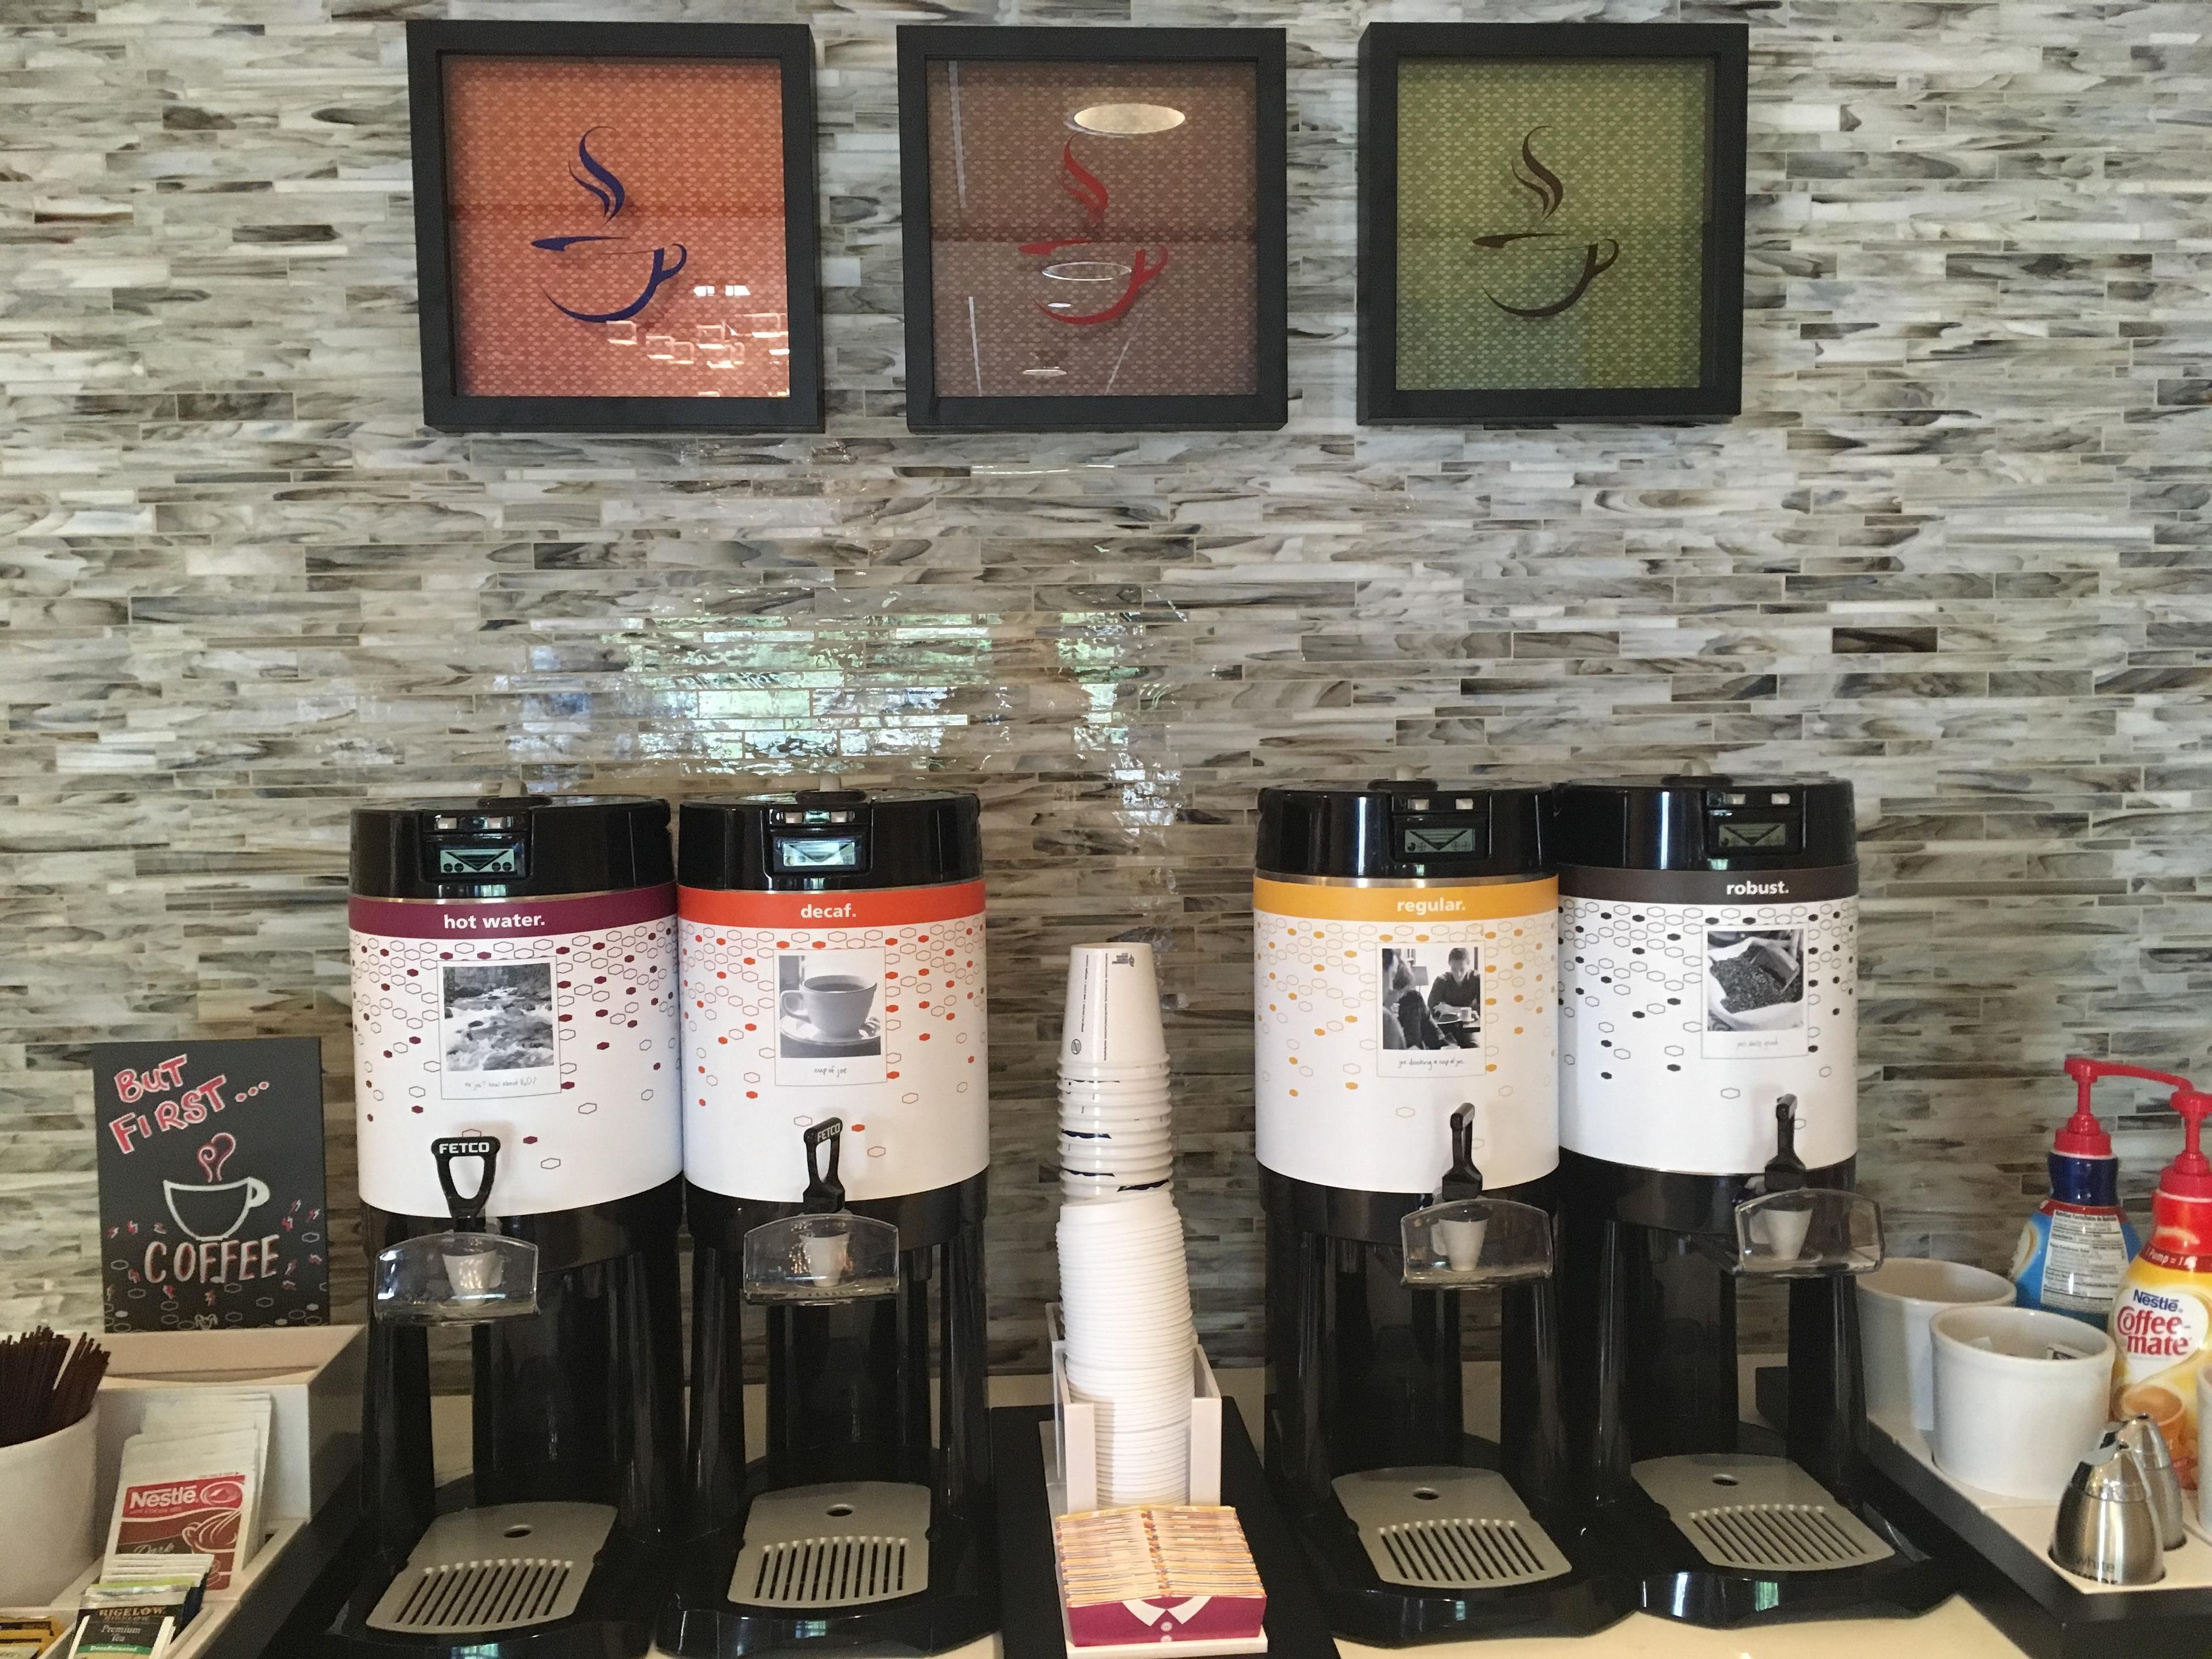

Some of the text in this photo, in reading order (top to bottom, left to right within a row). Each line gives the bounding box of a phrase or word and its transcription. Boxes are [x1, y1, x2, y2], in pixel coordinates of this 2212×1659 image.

[1726, 880, 1789, 895] robust.
[800, 903, 857, 918] decaf.
[1397, 897, 1466, 916] regular.
[444, 913, 546, 929] hot water.
[828, 1065, 835, 1073] of
[836, 1067, 847, 1078] joe
[817, 1122, 841, 1143] FETCO
[439, 1142, 490, 1154] FETCO
[144, 1234, 281, 1283] COFFEE
[2148, 1248, 2170, 1266] Pump
[2127, 1335, 2189, 1356] mate
[101, 1624, 142, 1634] Premium
